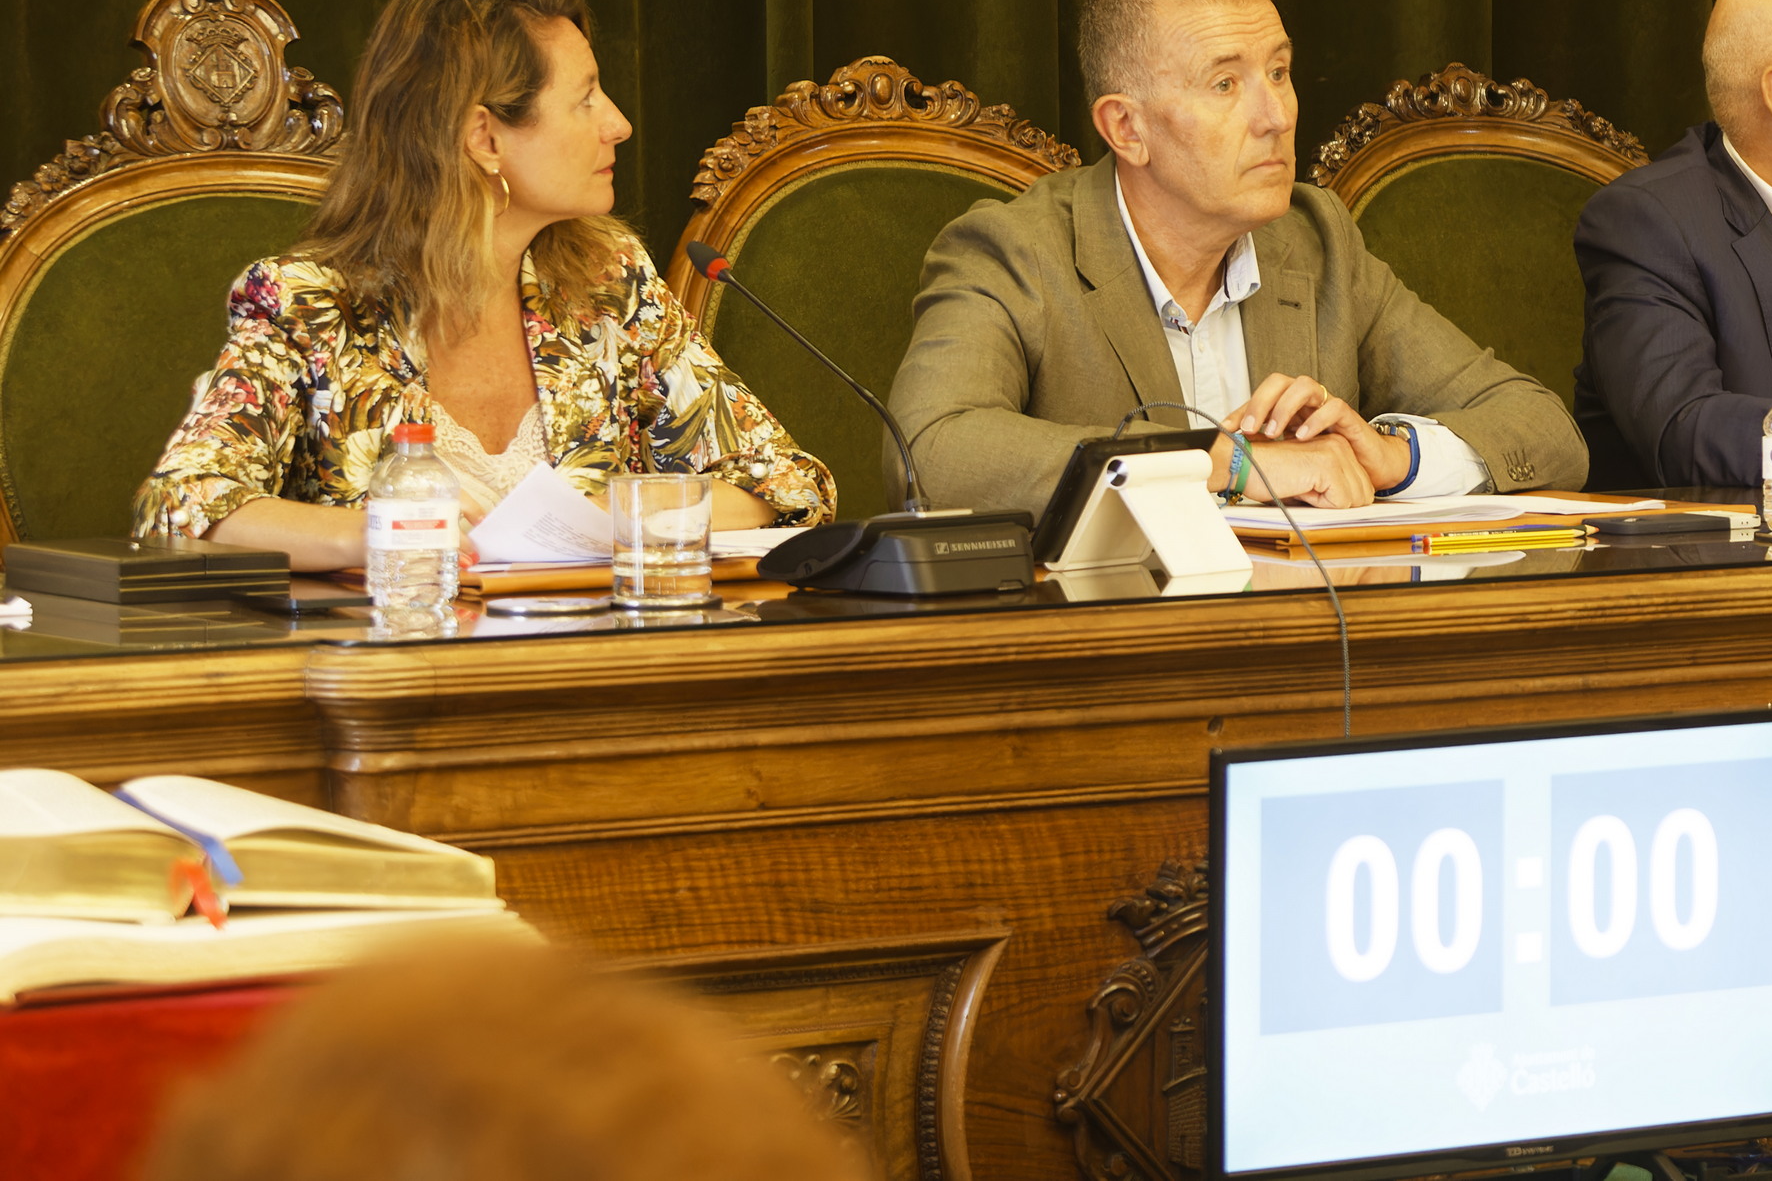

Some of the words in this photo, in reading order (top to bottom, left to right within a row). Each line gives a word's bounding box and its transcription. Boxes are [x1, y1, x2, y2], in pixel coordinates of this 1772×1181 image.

[951, 539, 1016, 552] SENNHEISER
[1325, 806, 1719, 982] 00:00
[1510, 1061, 1597, 1096] Castelló
